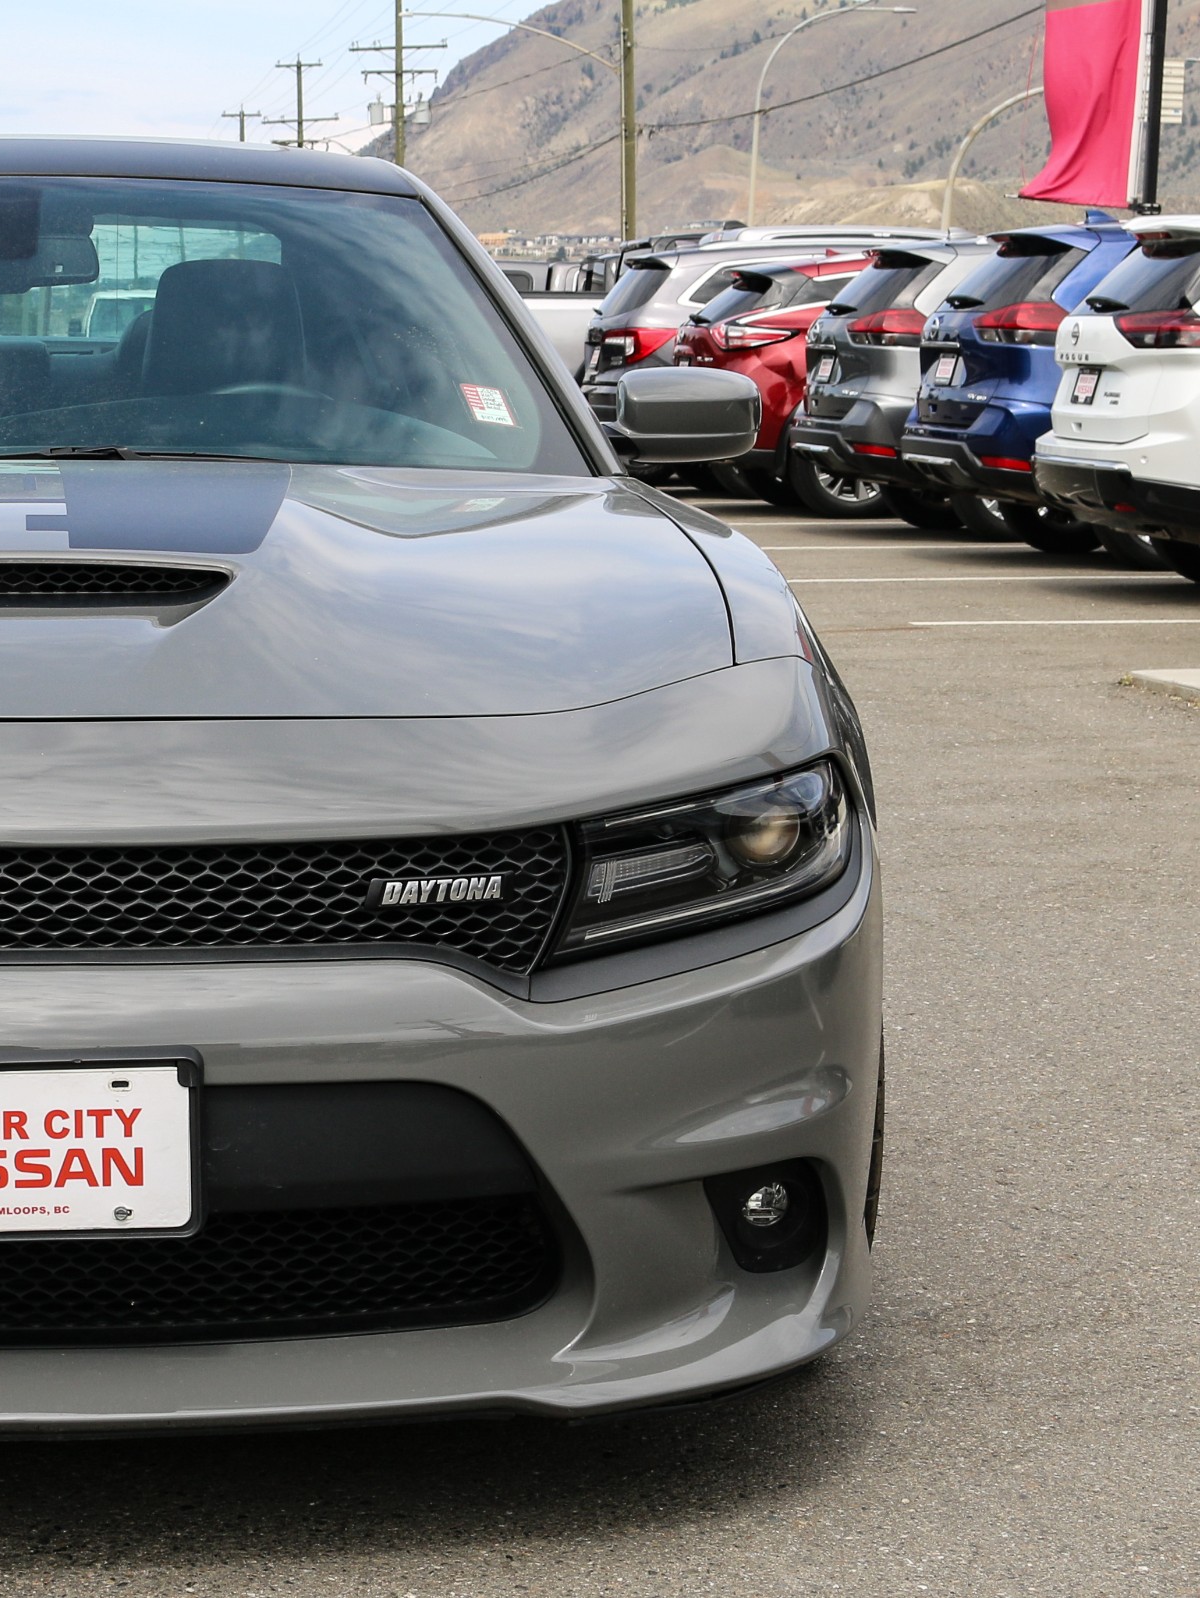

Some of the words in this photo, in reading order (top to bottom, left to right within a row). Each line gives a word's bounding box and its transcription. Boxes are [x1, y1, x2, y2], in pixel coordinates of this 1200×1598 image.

[382, 875, 502, 906] DAYTONA
[43, 1108, 142, 1140] CITY
[53, 1205, 71, 1215] BC
